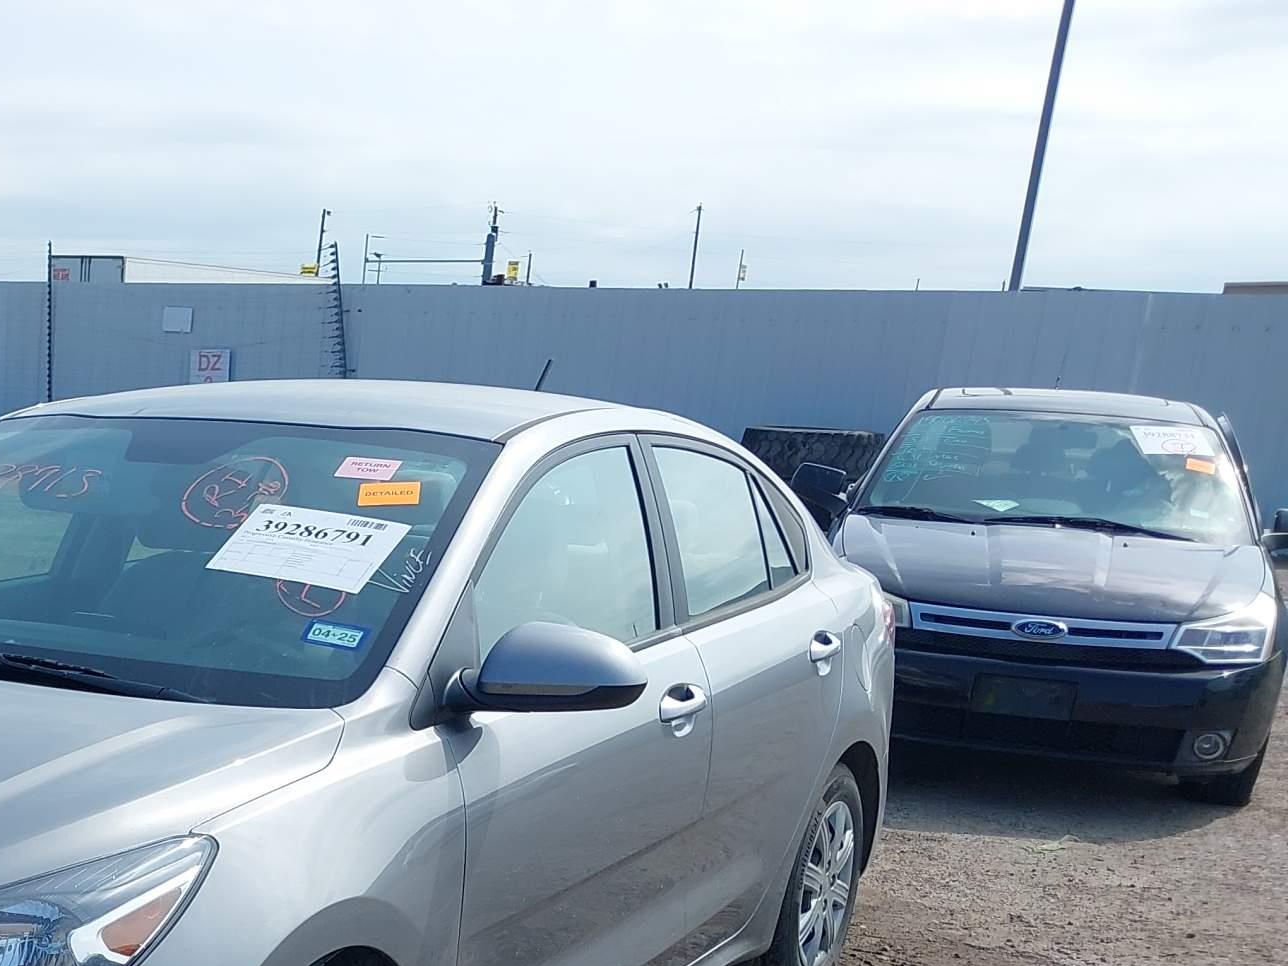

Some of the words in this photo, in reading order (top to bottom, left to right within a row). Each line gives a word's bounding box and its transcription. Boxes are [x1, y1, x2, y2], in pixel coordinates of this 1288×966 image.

[198, 352, 222, 371] DZ
[351, 461, 391, 469] RETURN
[255, 519, 374, 547] 39286791
[1024, 623, 1055, 635] Ford
